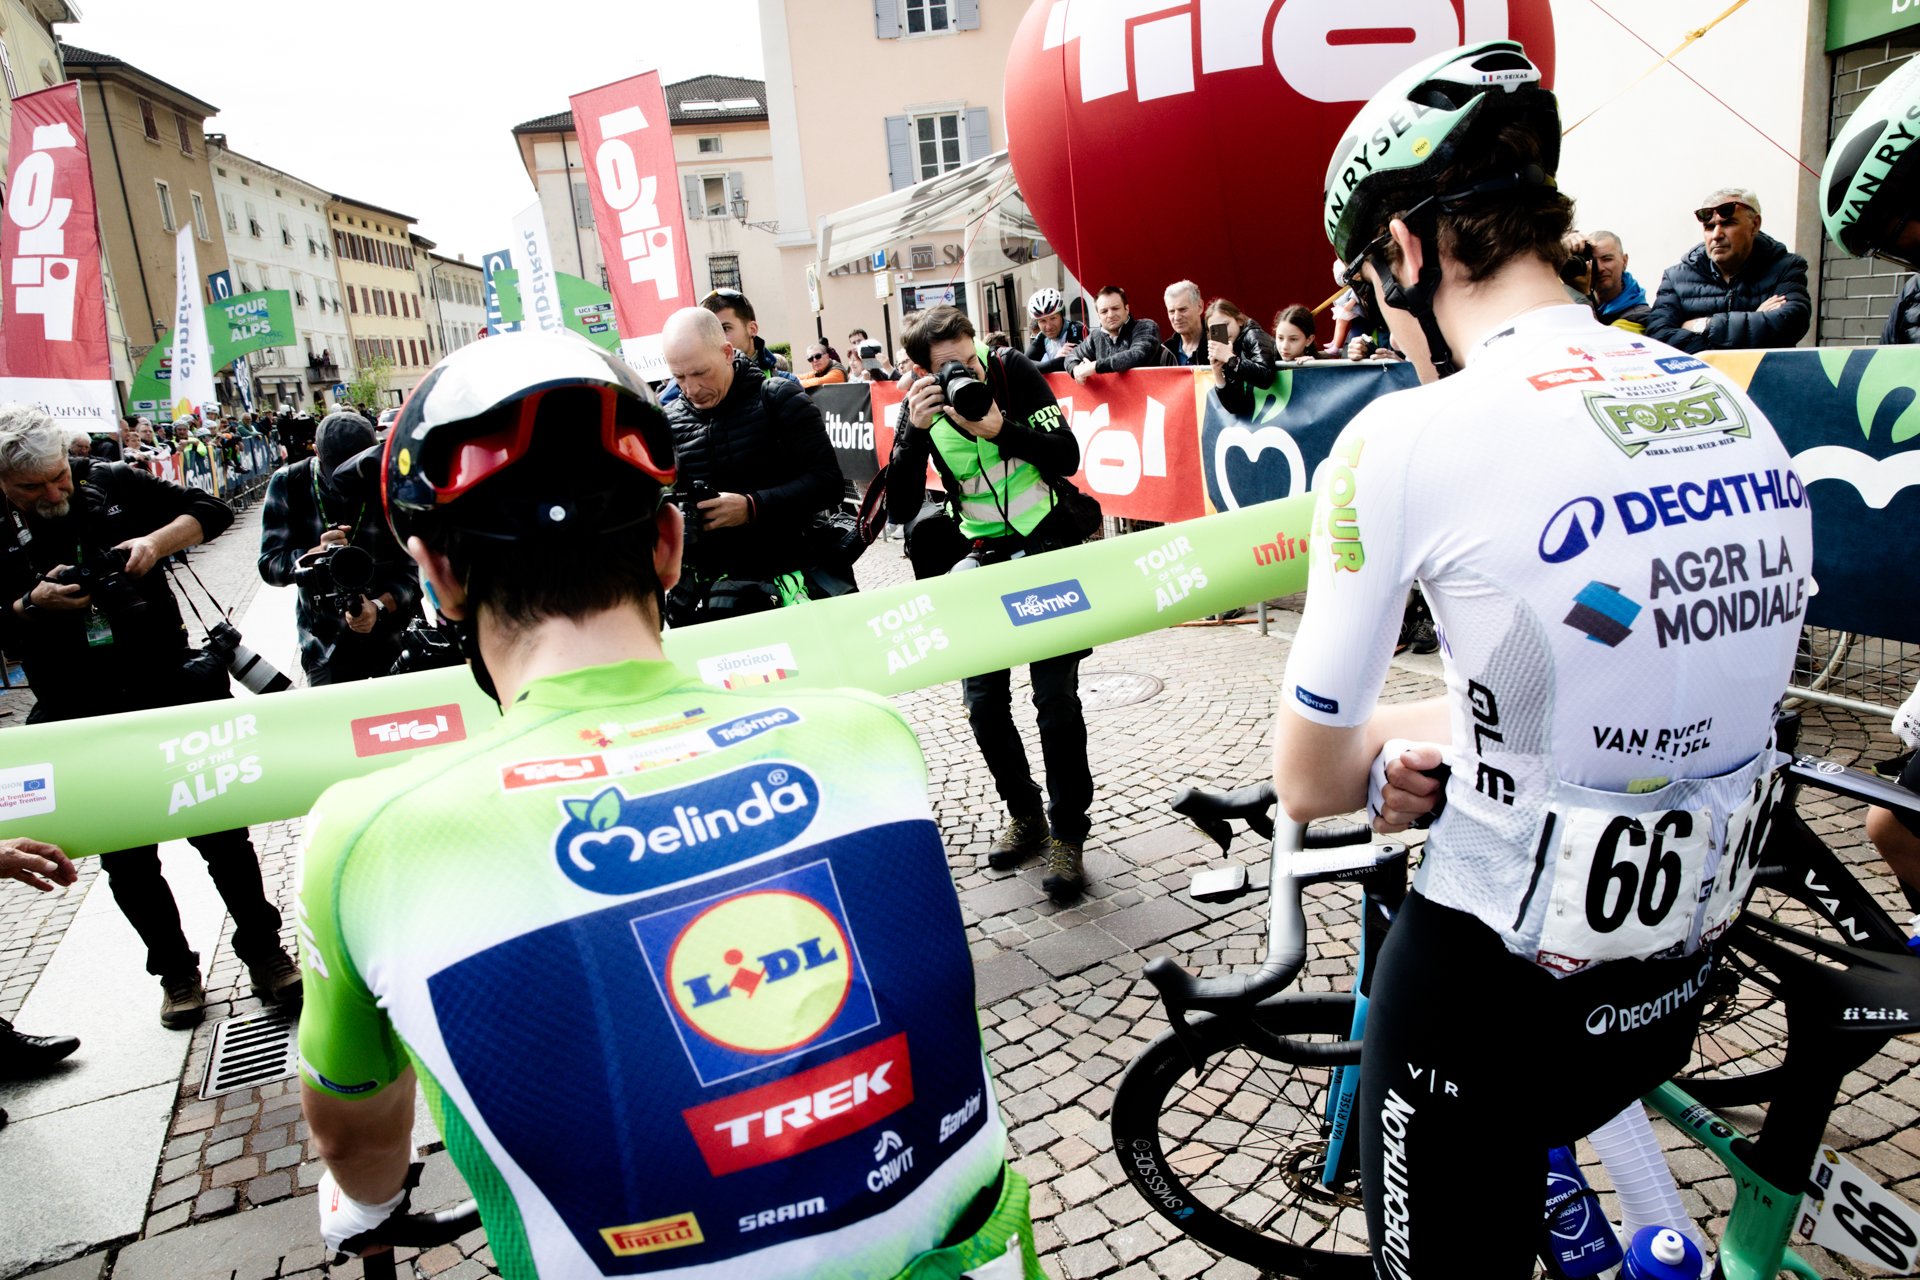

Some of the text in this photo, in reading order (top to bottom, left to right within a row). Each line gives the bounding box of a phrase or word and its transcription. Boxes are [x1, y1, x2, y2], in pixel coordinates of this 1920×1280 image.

[1328, 194, 1345, 236] AN
[1841, 172, 1884, 226] VAN
[225, 298, 268, 319] TOUR
[230, 320, 271, 343] ALPS
[825, 411, 874, 450] ittoria
[1027, 404, 1061, 428] FOTO
[1040, 416, 1060, 433] TV
[1602, 390, 1728, 435] FORST
[1327, 437, 1366, 574] TOUR
[1134, 535, 1193, 577] TOUR
[1650, 535, 1793, 600] AG2R LA
[1010, 590, 1080, 620] TRENTINO
[1156, 566, 1209, 613] ALPS
[865, 594, 936, 638] TOUR
[1653, 577, 1805, 649] MONDIALE
[887, 626, 950, 676] ALPS
[159, 713, 259, 764] TOUR
[369, 714, 449, 742] Tirol
[186, 748, 235, 773] OF THE
[513, 759, 595, 780] Tirol
[168, 754, 263, 816] ALPS
[568, 781, 809, 872] Melinda
[1337, 866, 1379, 880] VAN RYSEL
[1585, 809, 1693, 934] 66
[1804, 868, 1870, 942] VAN
[1619, 959, 1713, 1032] DECATHLO
[714, 1060, 894, 1148] TREK
[939, 1088, 982, 1143] Santini
[1333, 1092, 1353, 1141] VAN RYSEL
[867, 1147, 914, 1194] CRIVIT
[1380, 1088, 1416, 1260] DECATHLON
[739, 1196, 826, 1233] SRAM
[1545, 1186, 1578, 1207] ECATHLON
[611, 1218, 694, 1252] PIRELLI
[1832, 1179, 1919, 1272] 66
[1561, 1236, 1606, 1263] ELITE
